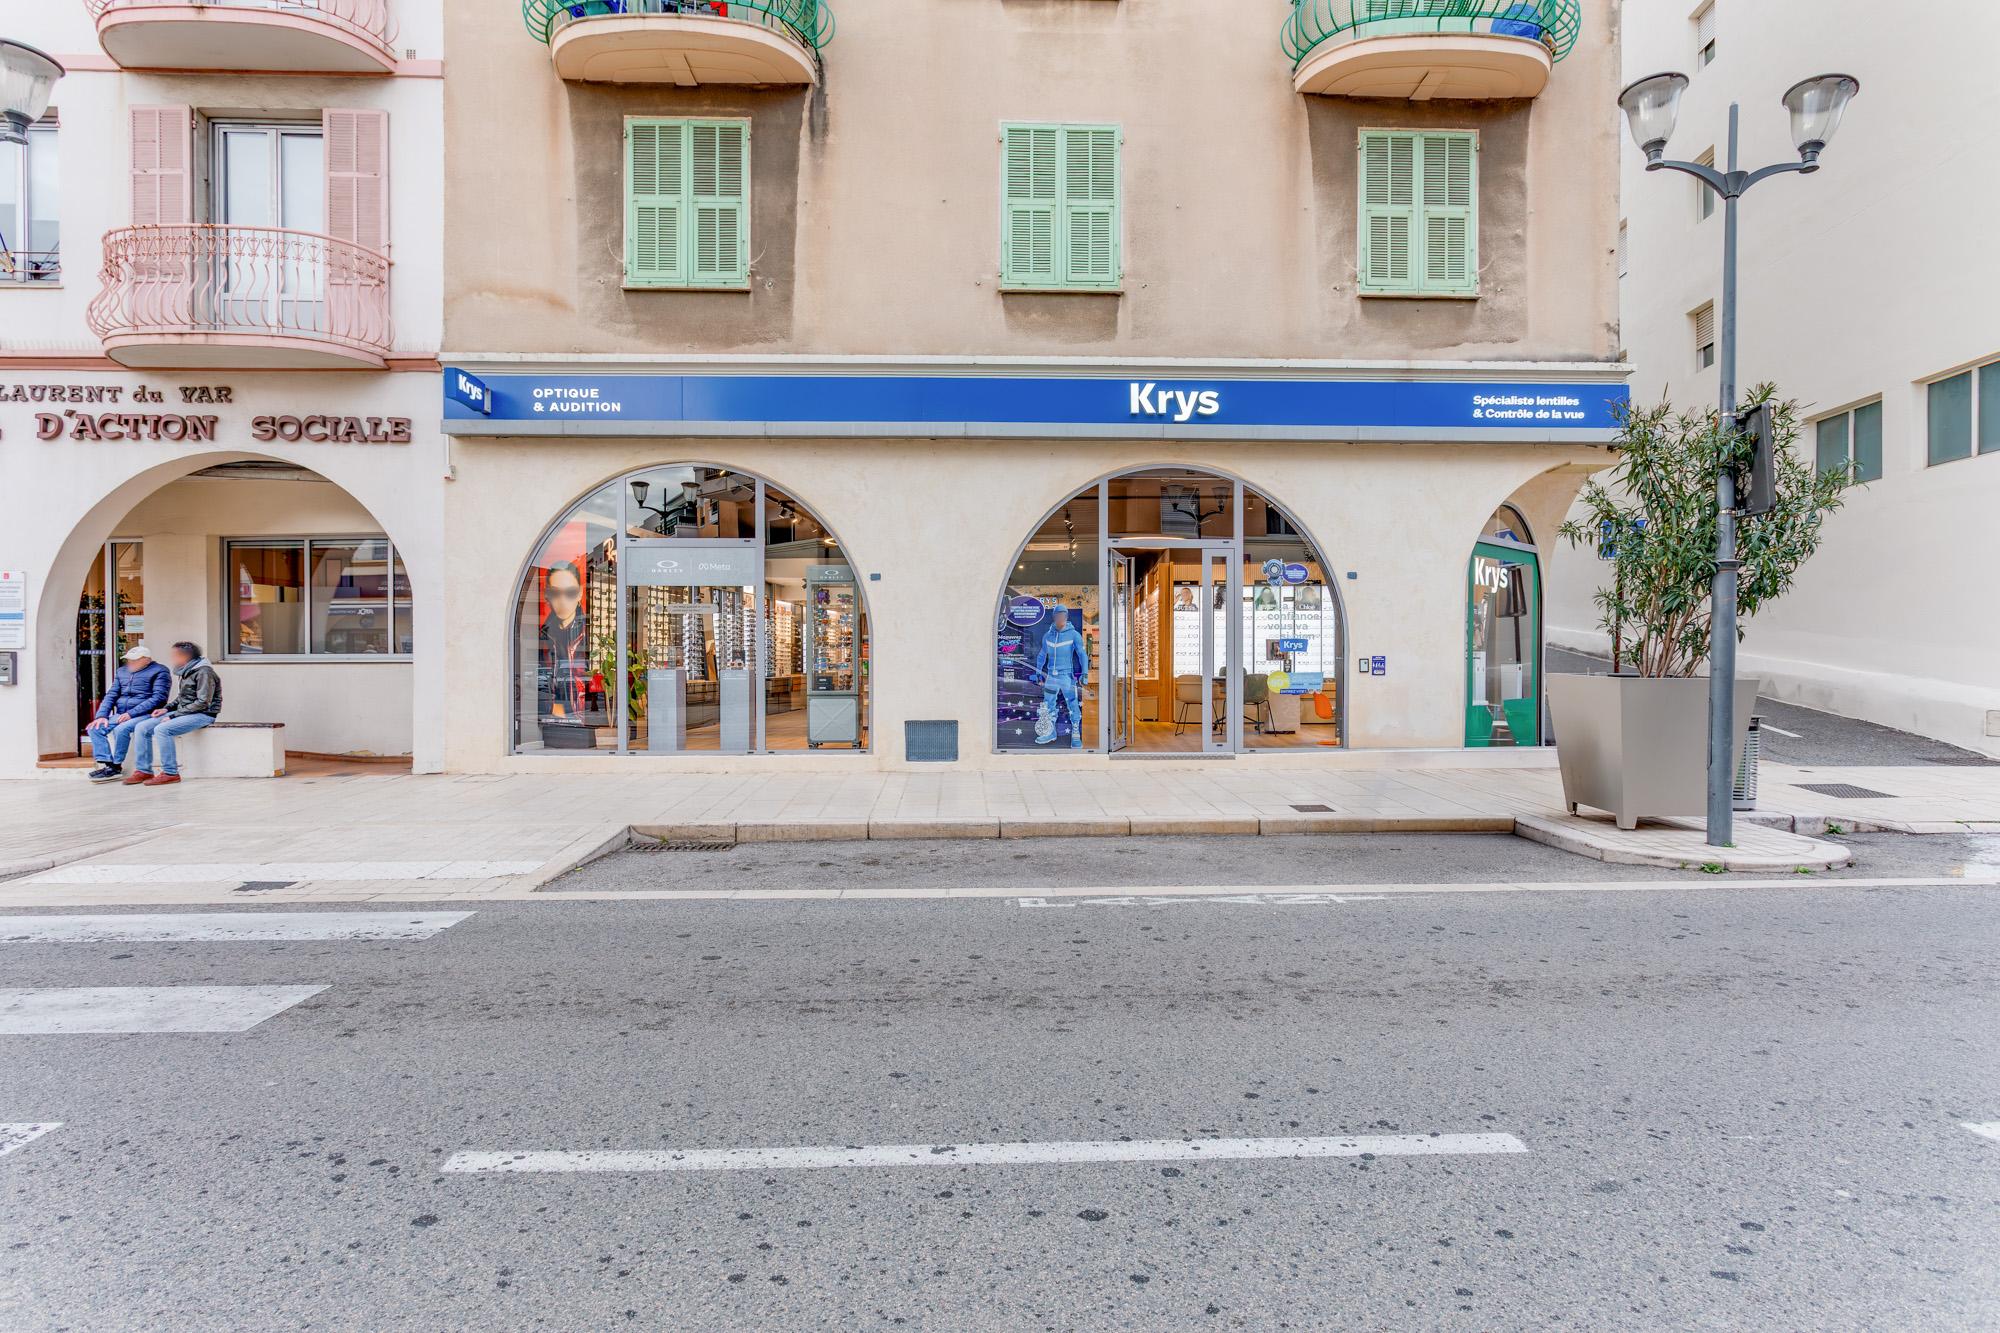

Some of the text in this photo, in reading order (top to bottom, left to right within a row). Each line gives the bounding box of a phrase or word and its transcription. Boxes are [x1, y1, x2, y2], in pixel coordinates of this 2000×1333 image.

[0, 384, 233, 404] LAURENT du VAR
[458, 374, 483, 400] Krys
[533, 388, 600, 399] OPTIQUE
[532, 401, 621, 412] & AUDITION
[1130, 382, 1220, 422] Krys
[1472, 395, 1580, 407] Spécialiste lentilles
[1472, 408, 1585, 419] & Contrôle de la vue
[251, 414, 412, 443] SOCIALE
[1474, 557, 1509, 594] Krys
[1283, 641, 1304, 650] Krys
